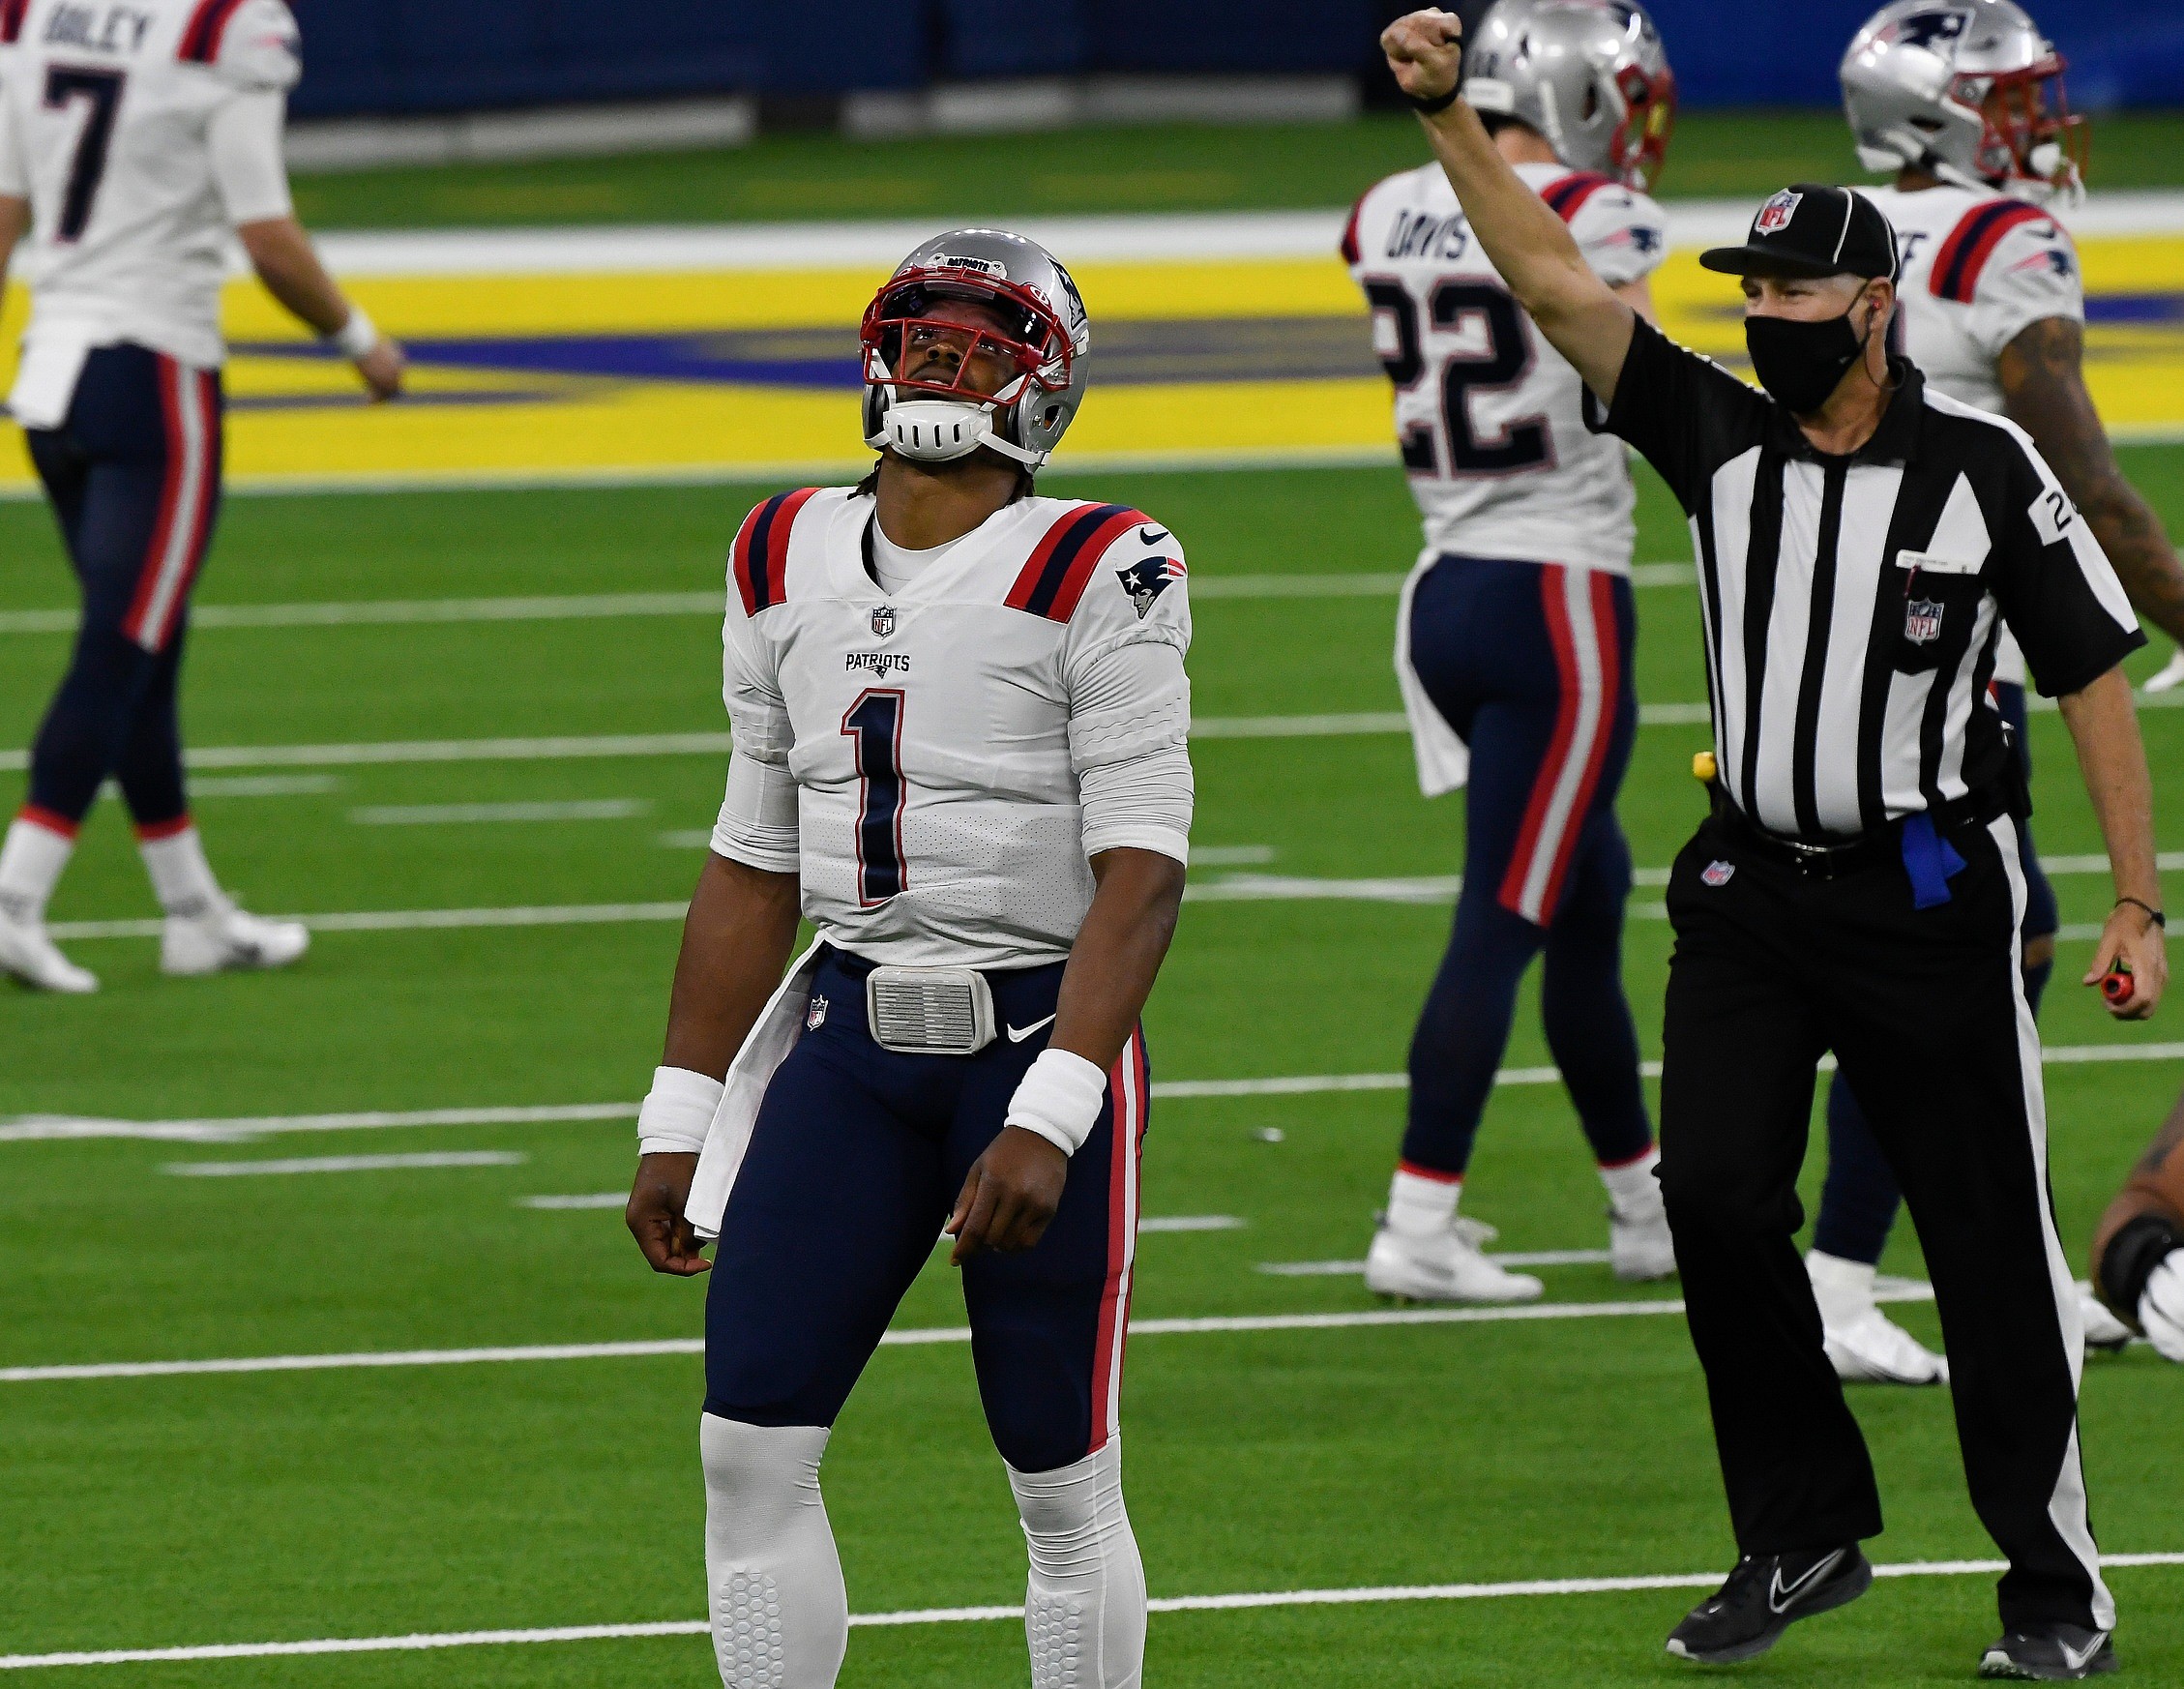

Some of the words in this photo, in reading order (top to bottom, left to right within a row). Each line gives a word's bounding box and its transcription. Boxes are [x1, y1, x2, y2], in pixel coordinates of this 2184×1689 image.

[43, 62, 128, 244] 7
[1385, 208, 1467, 259] DAVIS
[1362, 273, 1558, 480] 22
[845, 653, 910, 672] PATRIOTS
[841, 687, 908, 908] 1
